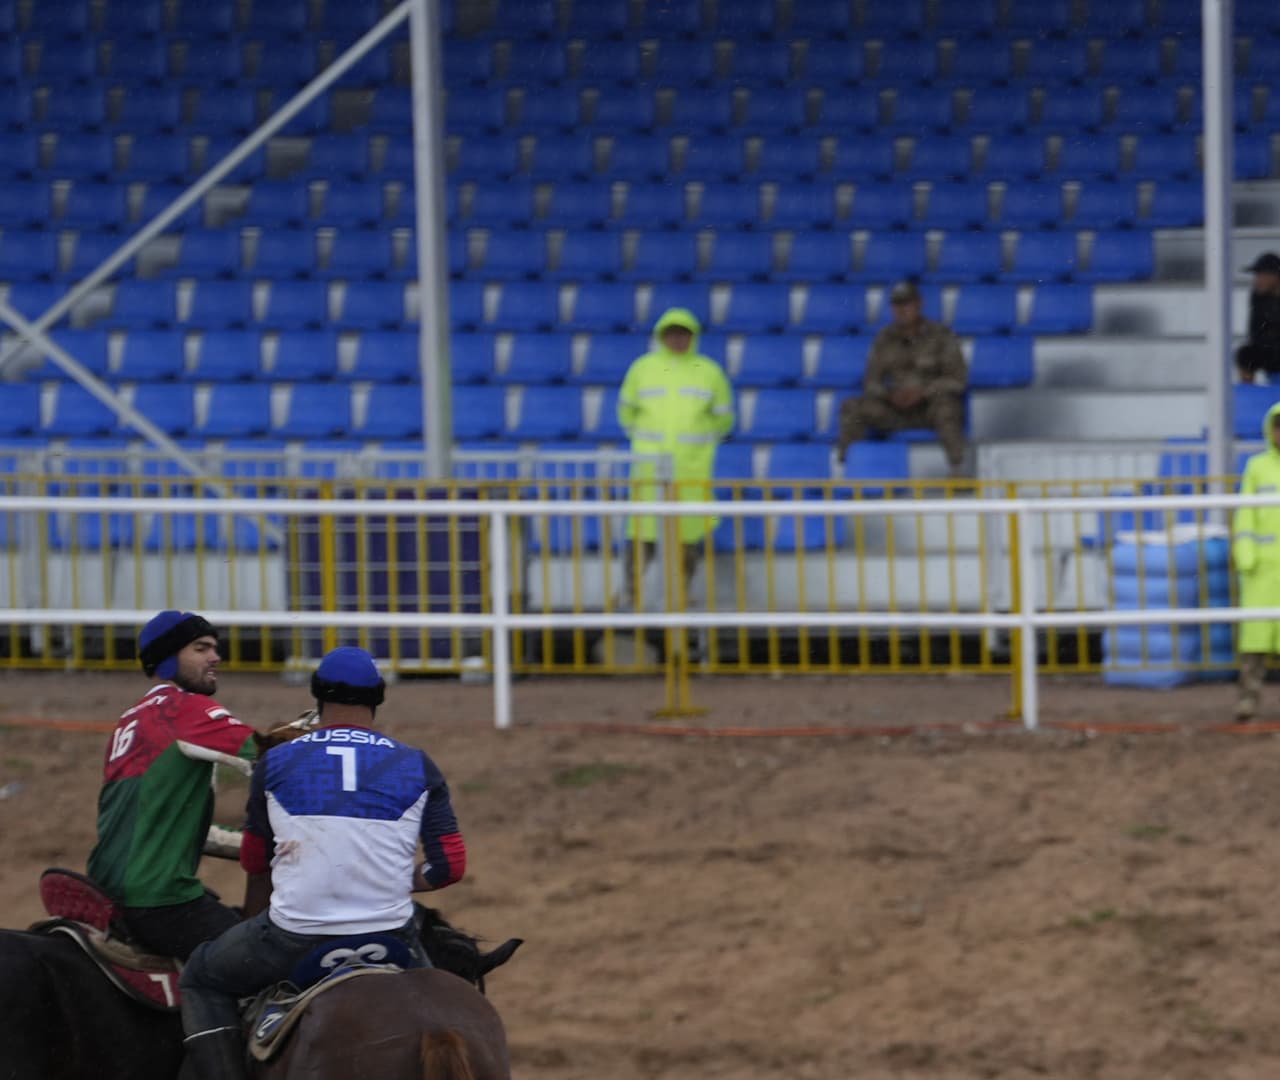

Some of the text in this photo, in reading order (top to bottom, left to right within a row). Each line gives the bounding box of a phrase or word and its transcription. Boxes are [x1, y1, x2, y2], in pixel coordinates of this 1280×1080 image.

[108, 718, 138, 763] 16
[291, 729, 396, 749] RUSSIA
[326, 745, 357, 792] 1
